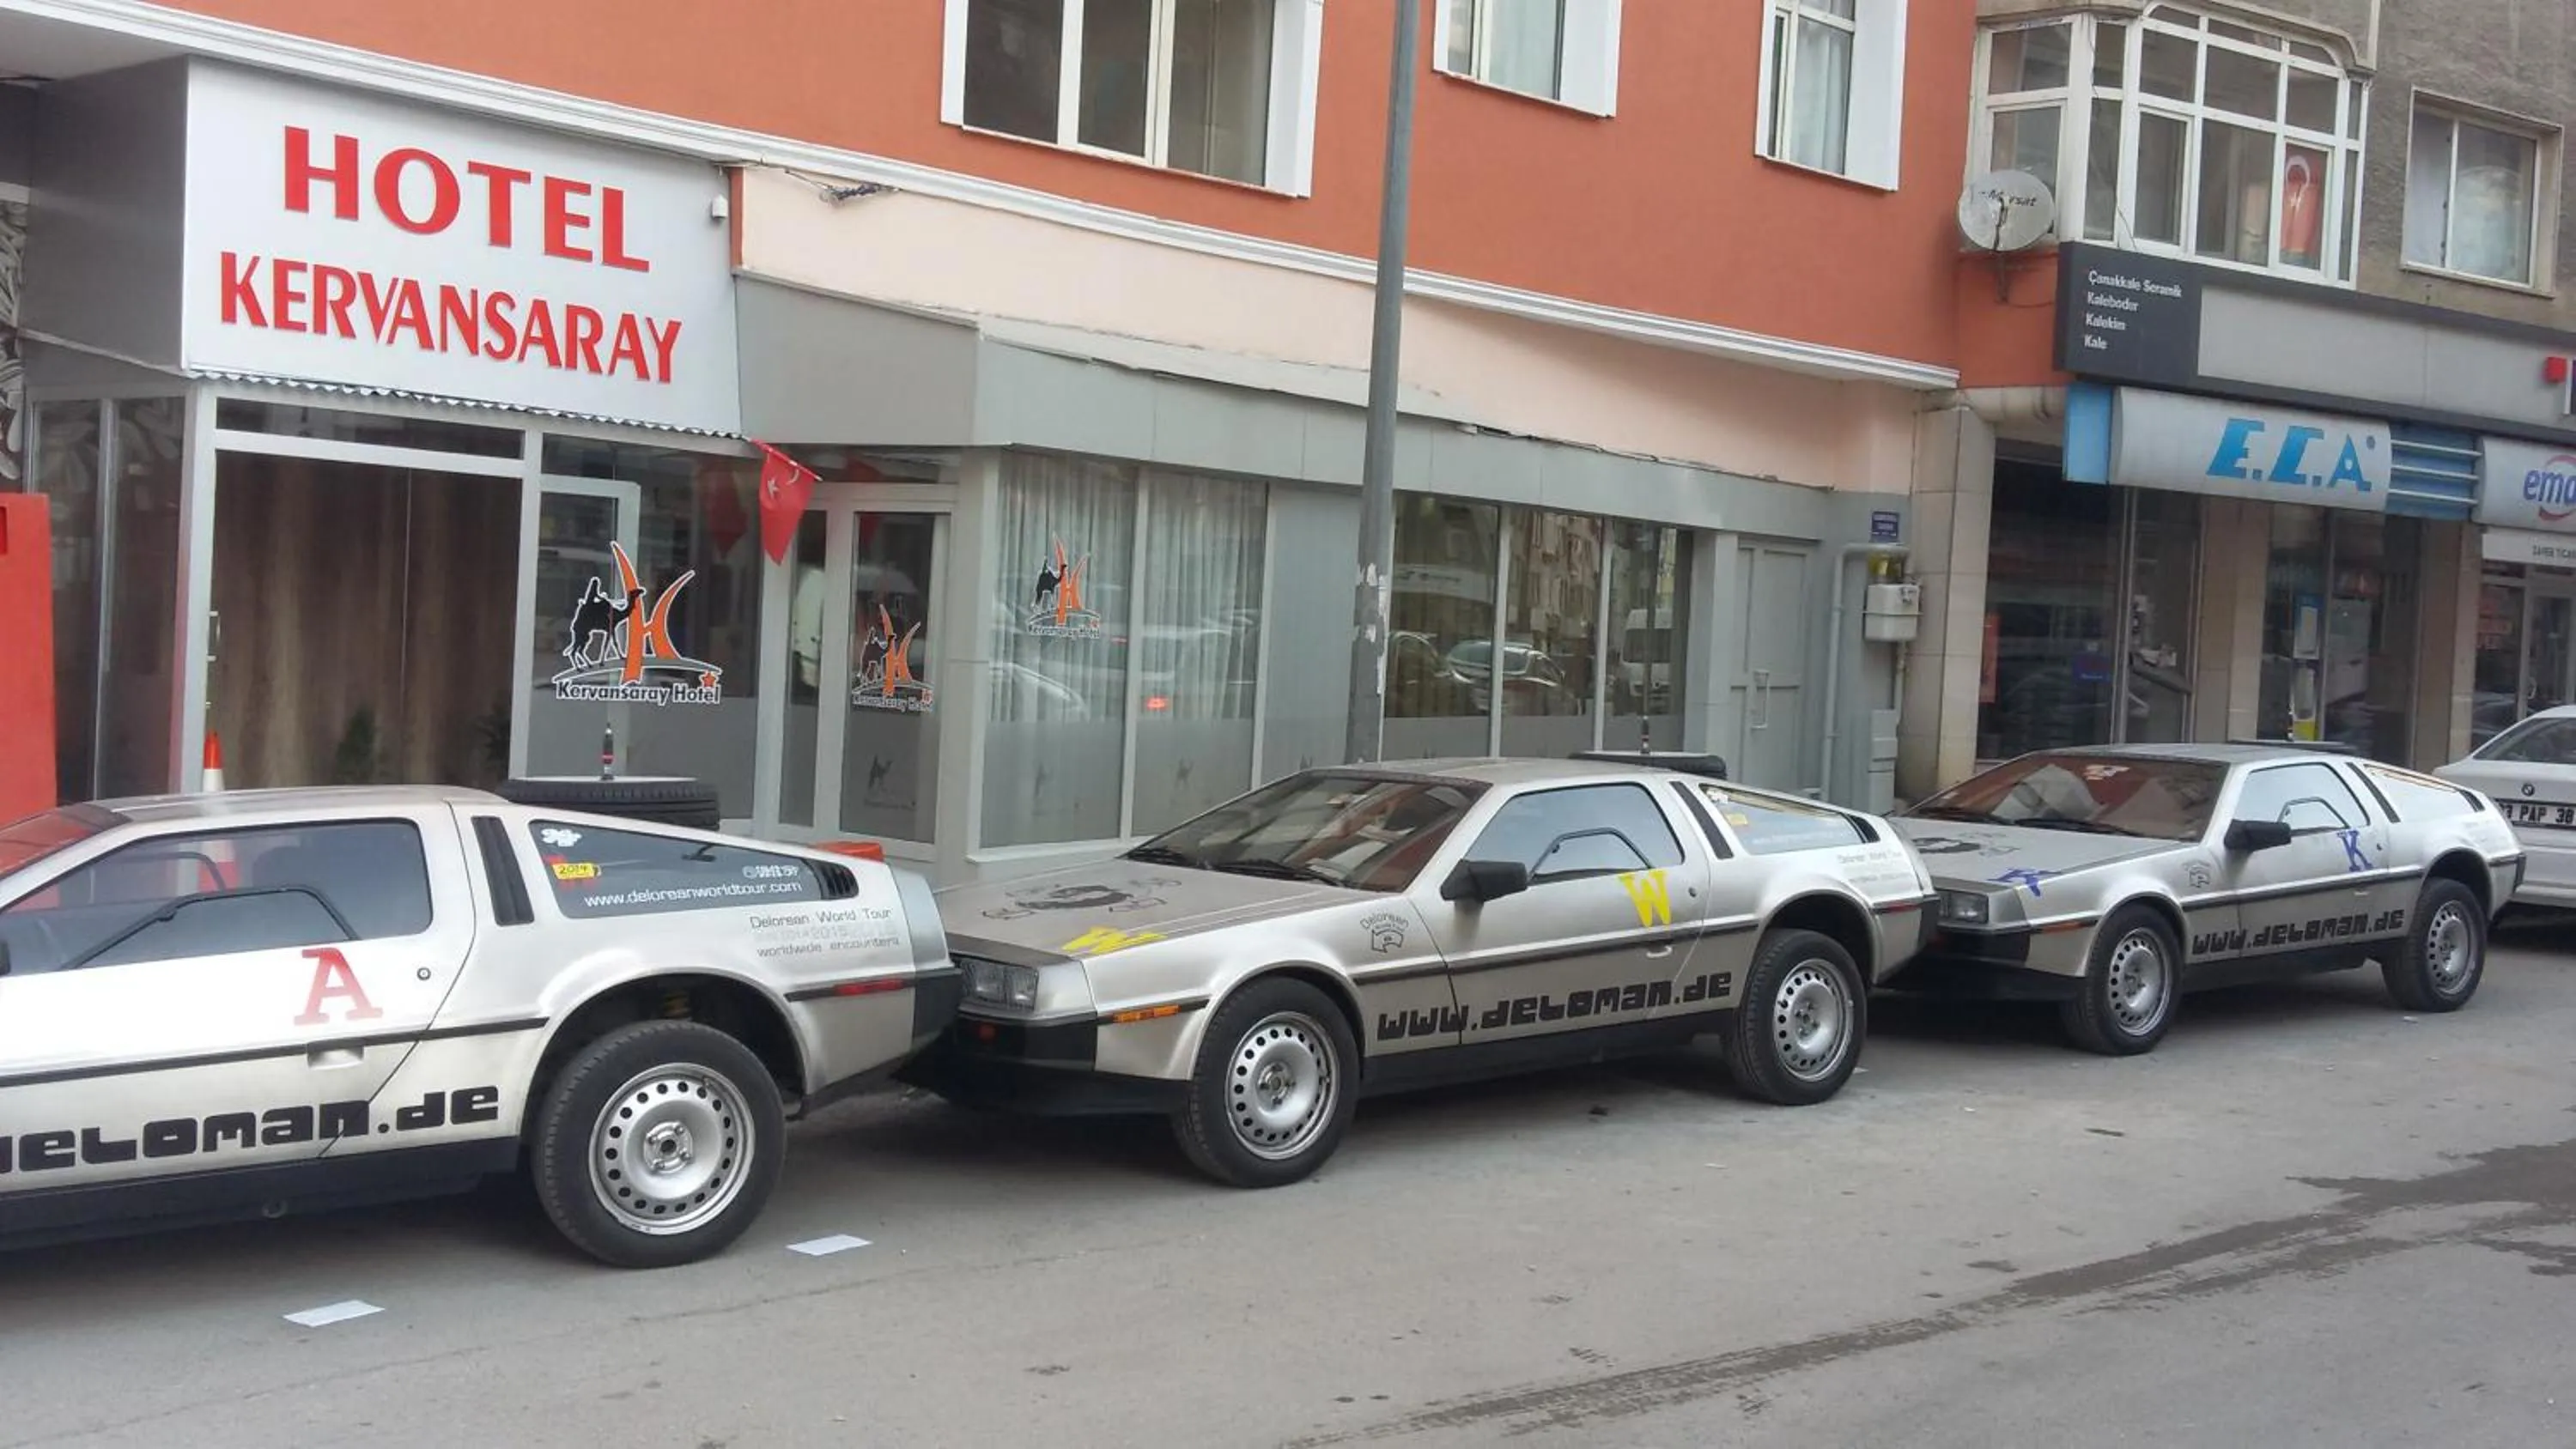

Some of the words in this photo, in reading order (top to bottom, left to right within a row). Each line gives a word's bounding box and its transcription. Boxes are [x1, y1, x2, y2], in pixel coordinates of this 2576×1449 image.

[284, 125, 650, 272] HOTEL
[221, 252, 682, 384] KERVANSARAY
[2084, 334, 2108, 350] Kale
[556, 680, 670, 706] Kervansaray
[673, 683, 720, 704] Hotel
[2519, 805, 2547, 823] PAP
[2336, 829, 2373, 872] K
[750, 915, 810, 930] Delorean
[817, 908, 856, 925] World
[862, 906, 893, 920] Tour
[1618, 869, 1671, 928] W
[294, 947, 383, 1026] A
